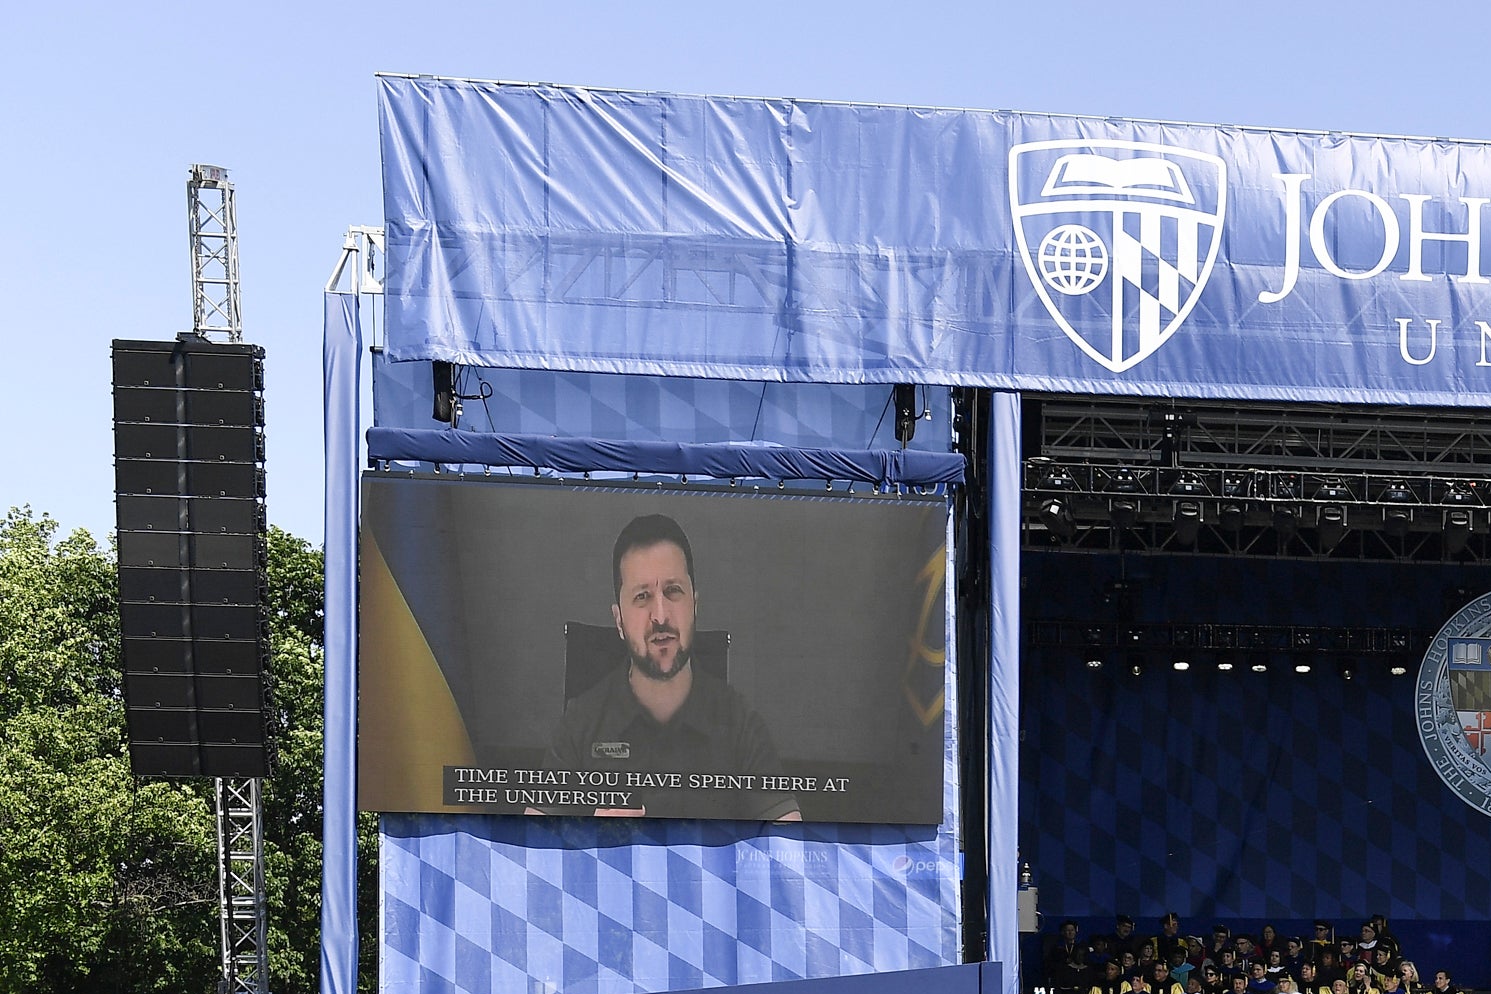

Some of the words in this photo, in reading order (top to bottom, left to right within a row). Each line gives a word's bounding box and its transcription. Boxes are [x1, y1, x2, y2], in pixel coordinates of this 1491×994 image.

[1428, 598, 1491, 664] HOPKINS
[1418, 680, 1438, 741] JOHNS
[1435, 753, 1464, 792] THE
[1443, 735, 1472, 767] VERITAS
[1471, 763, 1488, 777] VOS
[454, 768, 508, 784] TIME
[514, 769, 571, 785] THAT
[576, 771, 620, 787] YOU
[626, 773, 682, 788] HAVE
[688, 774, 755, 790] SPENT
[760, 776, 817, 792] HERE
[822, 778, 849, 793] AT
[454, 788, 498, 804] THE
[505, 790, 633, 807] UNIVERSITY
